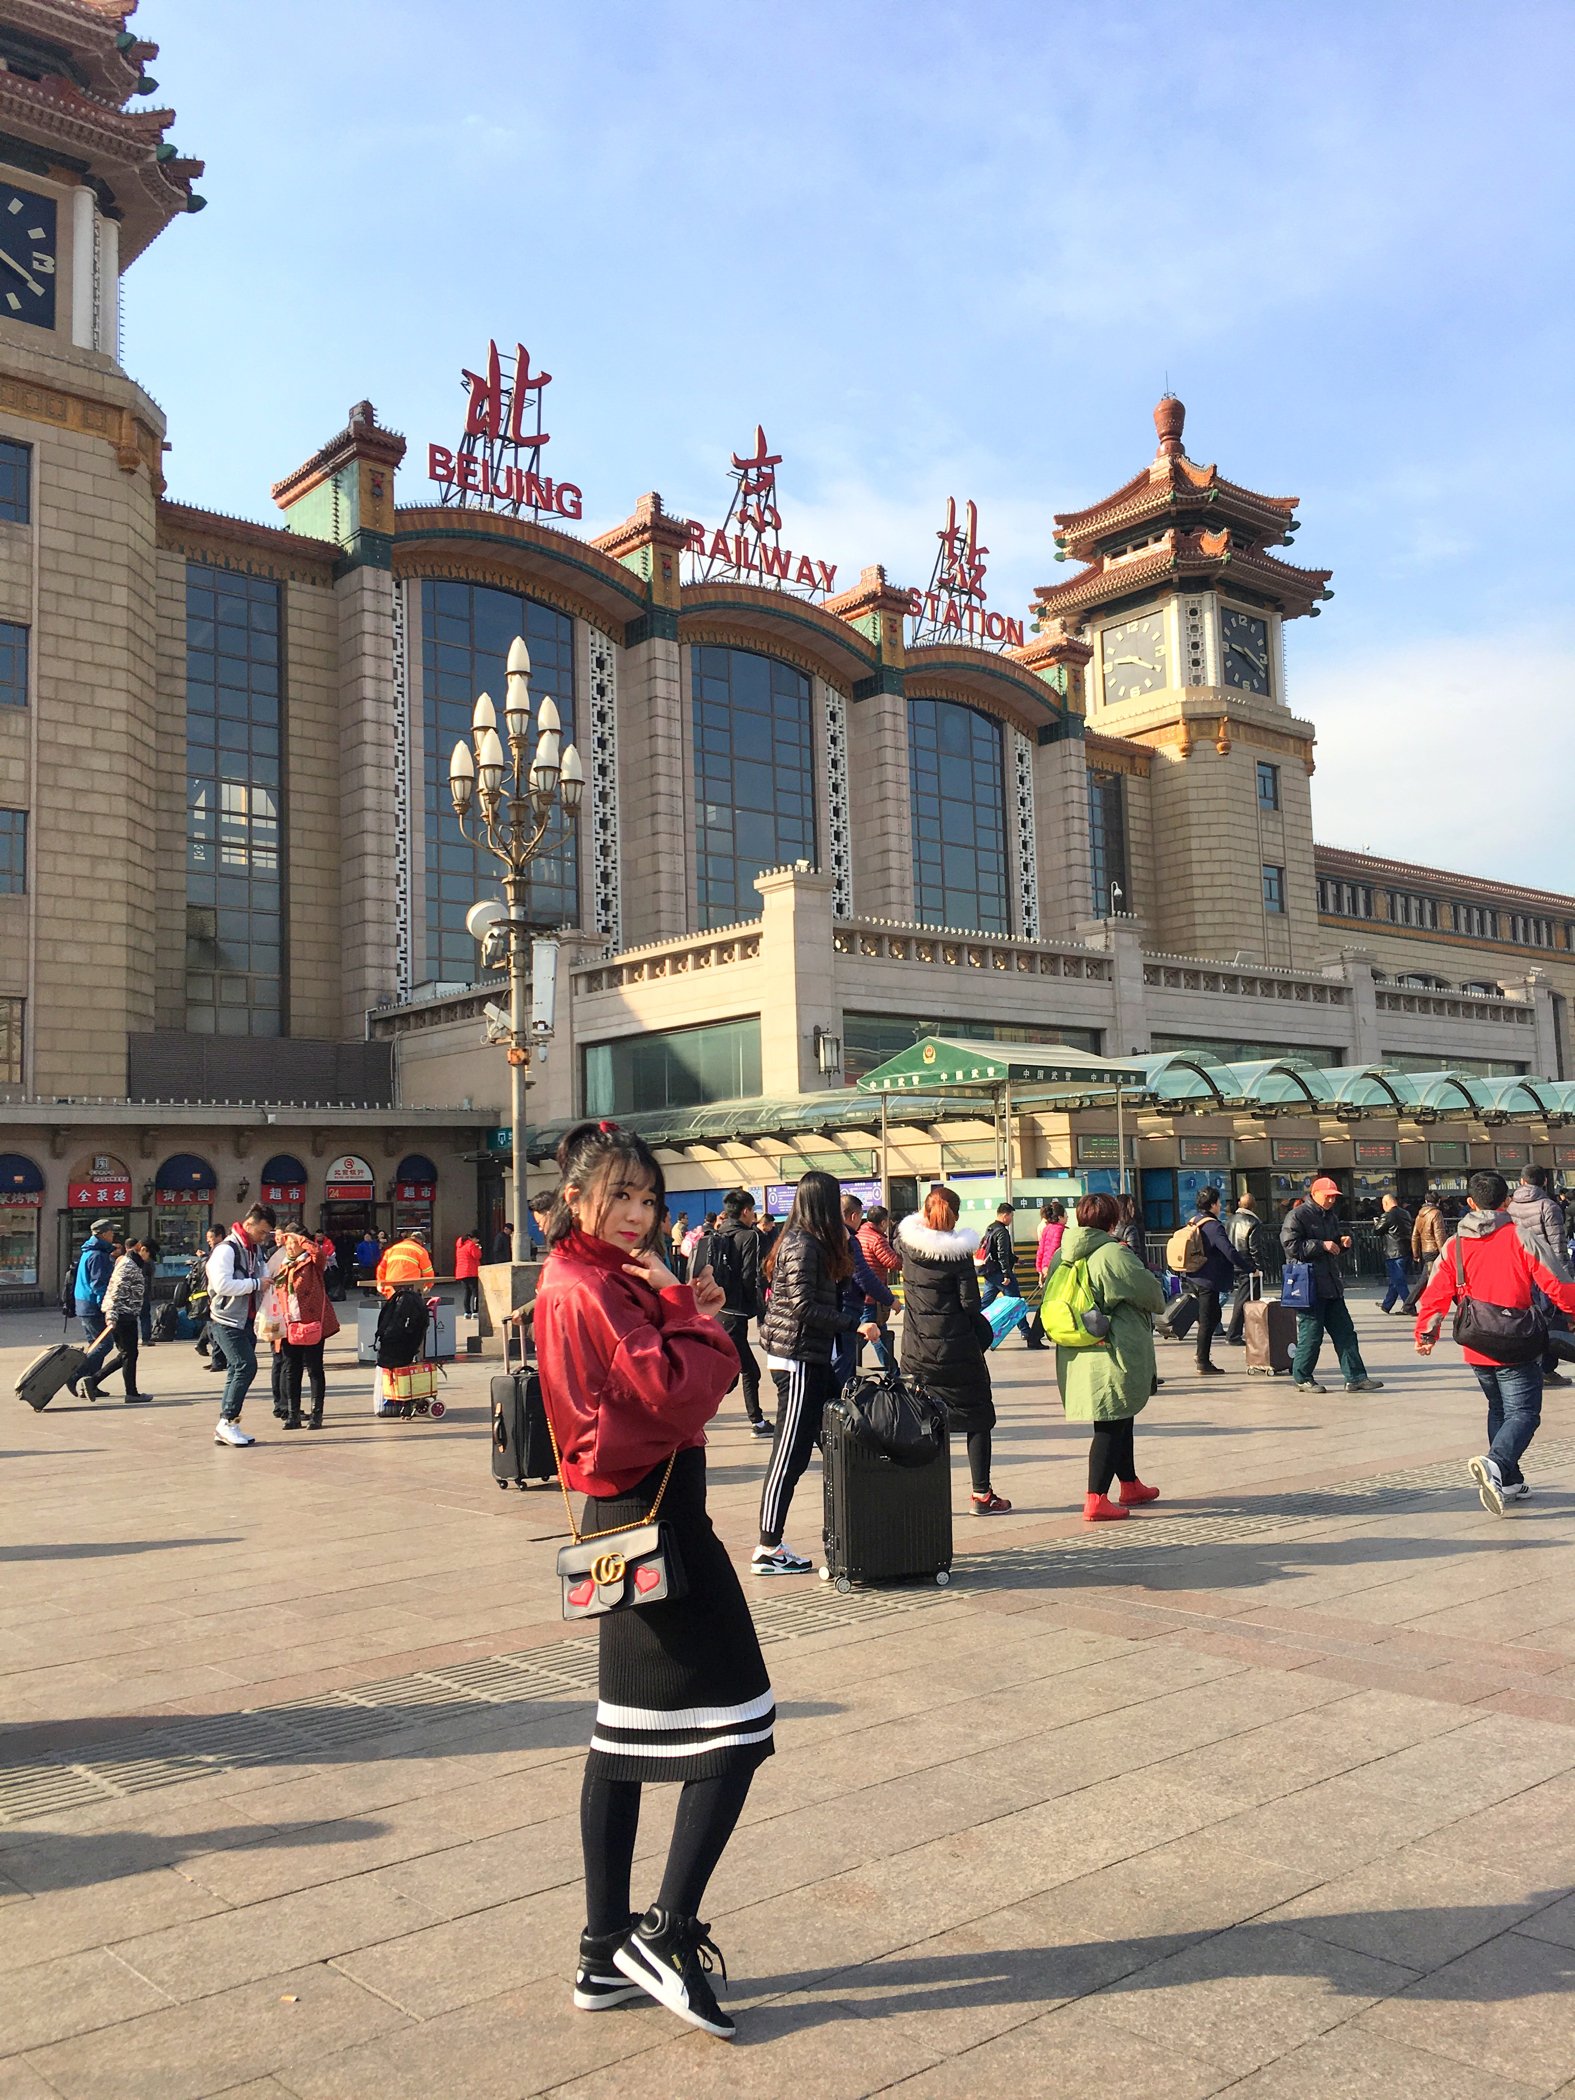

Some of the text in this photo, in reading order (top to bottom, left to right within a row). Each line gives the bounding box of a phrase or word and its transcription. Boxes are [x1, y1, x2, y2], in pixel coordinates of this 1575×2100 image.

[32, 251, 55, 274] 3
[461, 339, 990, 601] 北 京 站
[428, 442, 1024, 647] BEIJING RAILWAY STATION
[1238, 614, 1248, 627] 12
[1126, 621, 1139, 634] 12
[1259, 653, 1268, 665] 3
[940, 1066, 995, 1083] 中国武警
[1022, 1068, 1072, 1081] 中国武警
[1090, 1072, 1136, 1085] 中国武警
[869, 1075, 920, 1090] 中国武警
[78, 1189, 126, 1202] 全聚德
[269, 1187, 300, 1200] 超市
[328, 1188, 339, 1198] 24
[404, 1186, 431, 1198] 超市
